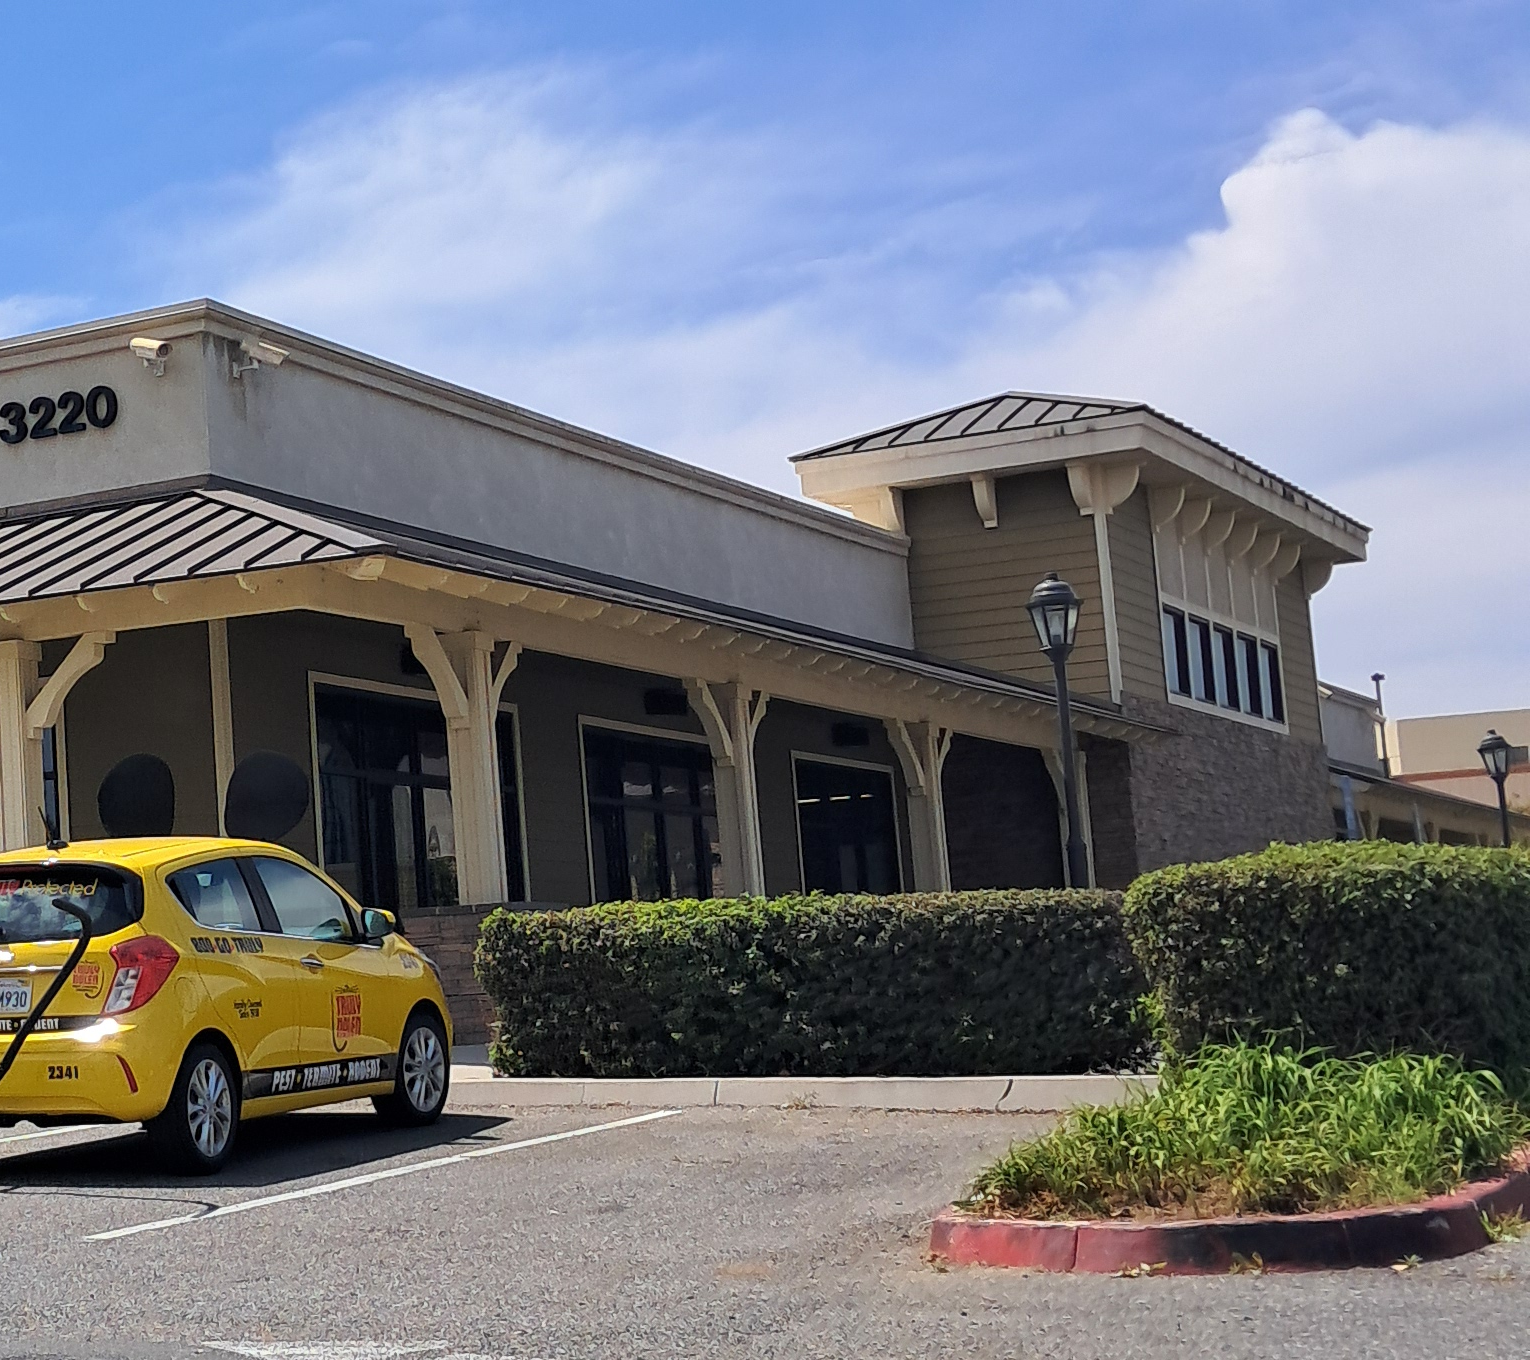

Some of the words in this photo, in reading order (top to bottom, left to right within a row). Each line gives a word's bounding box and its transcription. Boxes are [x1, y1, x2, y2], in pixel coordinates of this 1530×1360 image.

[19, 878, 99, 897] Protected
[47, 1065, 78, 1079] 2341
[271, 1069, 296, 1093] PEST
[302, 1063, 342, 1089] TERMITE
[347, 1058, 381, 1082] RODENT
